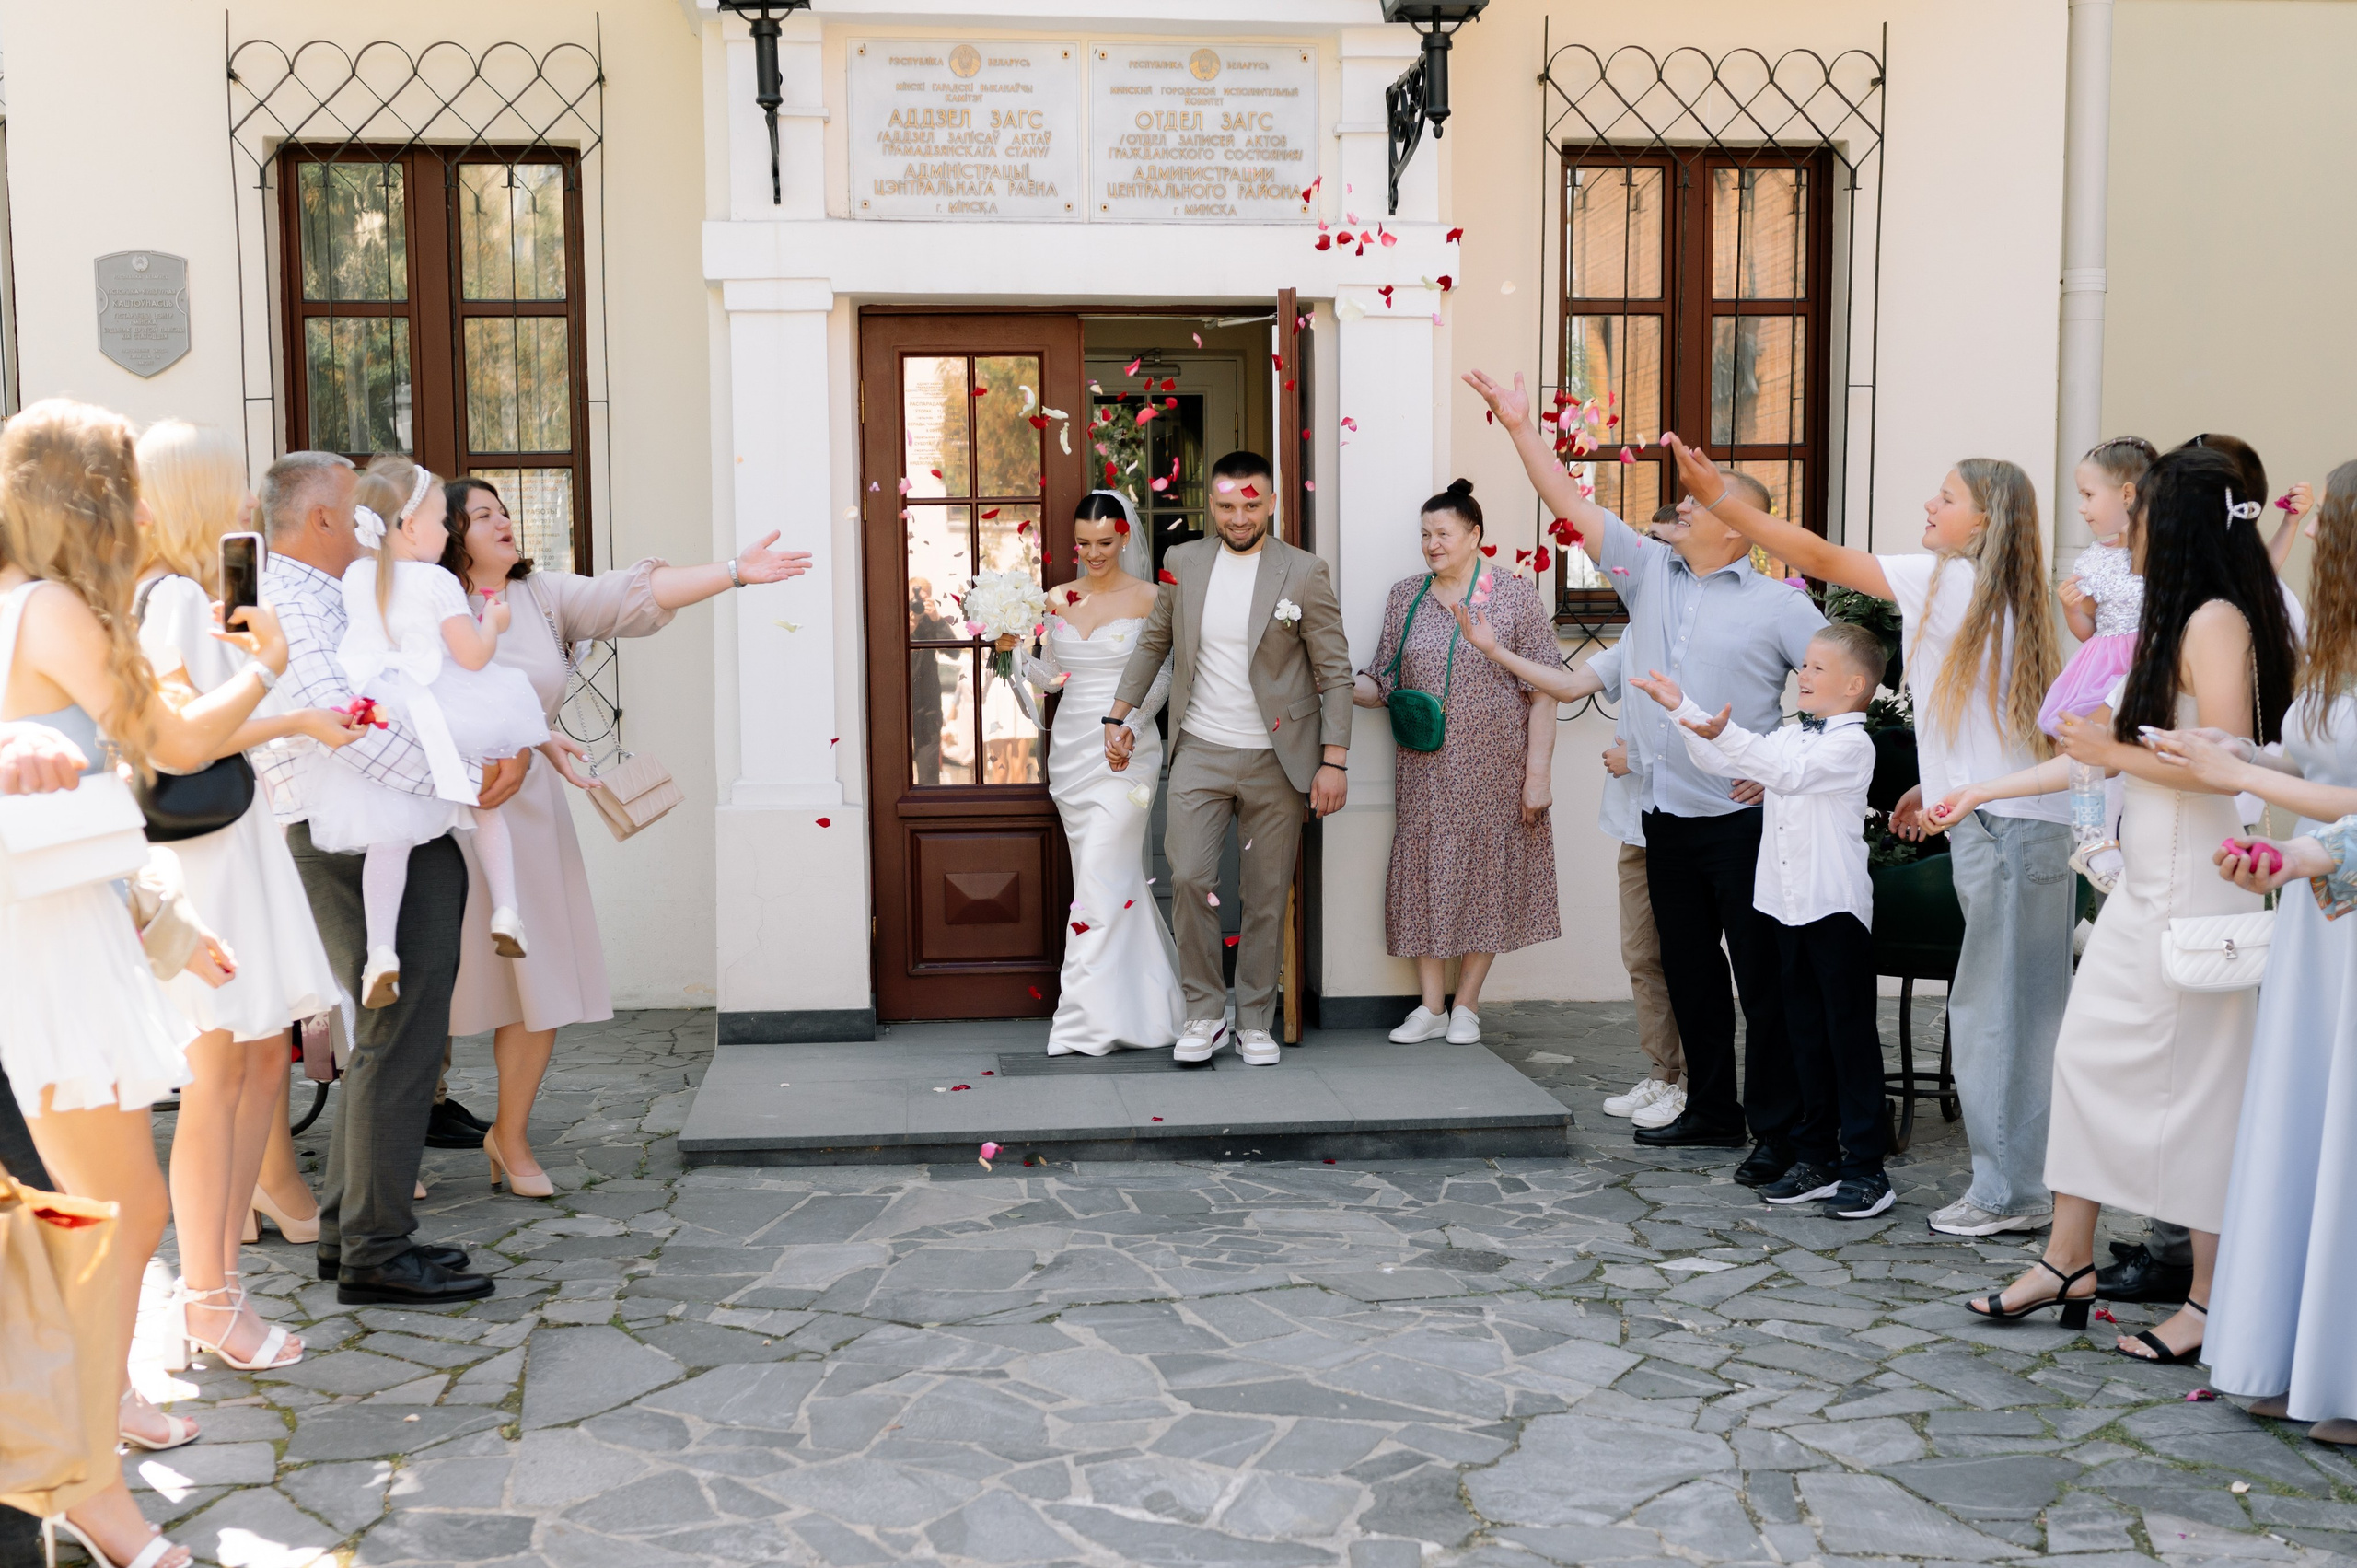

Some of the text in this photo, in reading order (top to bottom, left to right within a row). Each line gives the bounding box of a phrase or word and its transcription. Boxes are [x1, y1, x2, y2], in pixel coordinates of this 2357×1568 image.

[988, 58, 1031, 67] БЕЛАРУСЬ
[1129, 61, 1269, 70] РЕСПУБЛИКА БЕЛАРУСЬ
[933, 83, 973, 92] ГАРАДСКІ
[1110, 86, 1153, 95] МИНСКИЙ
[1161, 87, 1216, 96] ГОРОДСКОЙ
[946, 94, 983, 102] КАМІТЭТ
[1185, 98, 1224, 106] КОМИТЕТ
[888, 109, 1043, 129] АДДЗЕЛ ЗАГС
[1136, 111, 1273, 131] ОТДЕЛ ЗАГС
[948, 130, 1000, 145] ЗАПІСАЎ
[1013, 131, 1051, 145] АКТАЎ
[1120, 134, 1287, 147] /ОТДЕЛ ЗАПИСЕЙ АКТОВ
[883, 145, 1050, 157] ГРАМАДЗЯНСКАГА СТАНУ/
[1109, 147, 1303, 161] ГРАЖДАНСКОГО СОСТОЯНИЯ/
[904, 162, 1029, 180] АДМІНІСТРАЦЫІ
[1133, 166, 1274, 182] АДМИНИСТРАЦИИ
[875, 180, 1058, 196] ЦЭНТРАЛЬНАГА РАЁНА
[1108, 183, 1302, 199] ЦЕНТРАЛЬНОГО РАЙОНА
[948, 201, 998, 214] МІНСКА
[1185, 204, 1237, 215] МИНСКА
[112, 298, 173, 308] КАШТОЎНАСЦЬ
